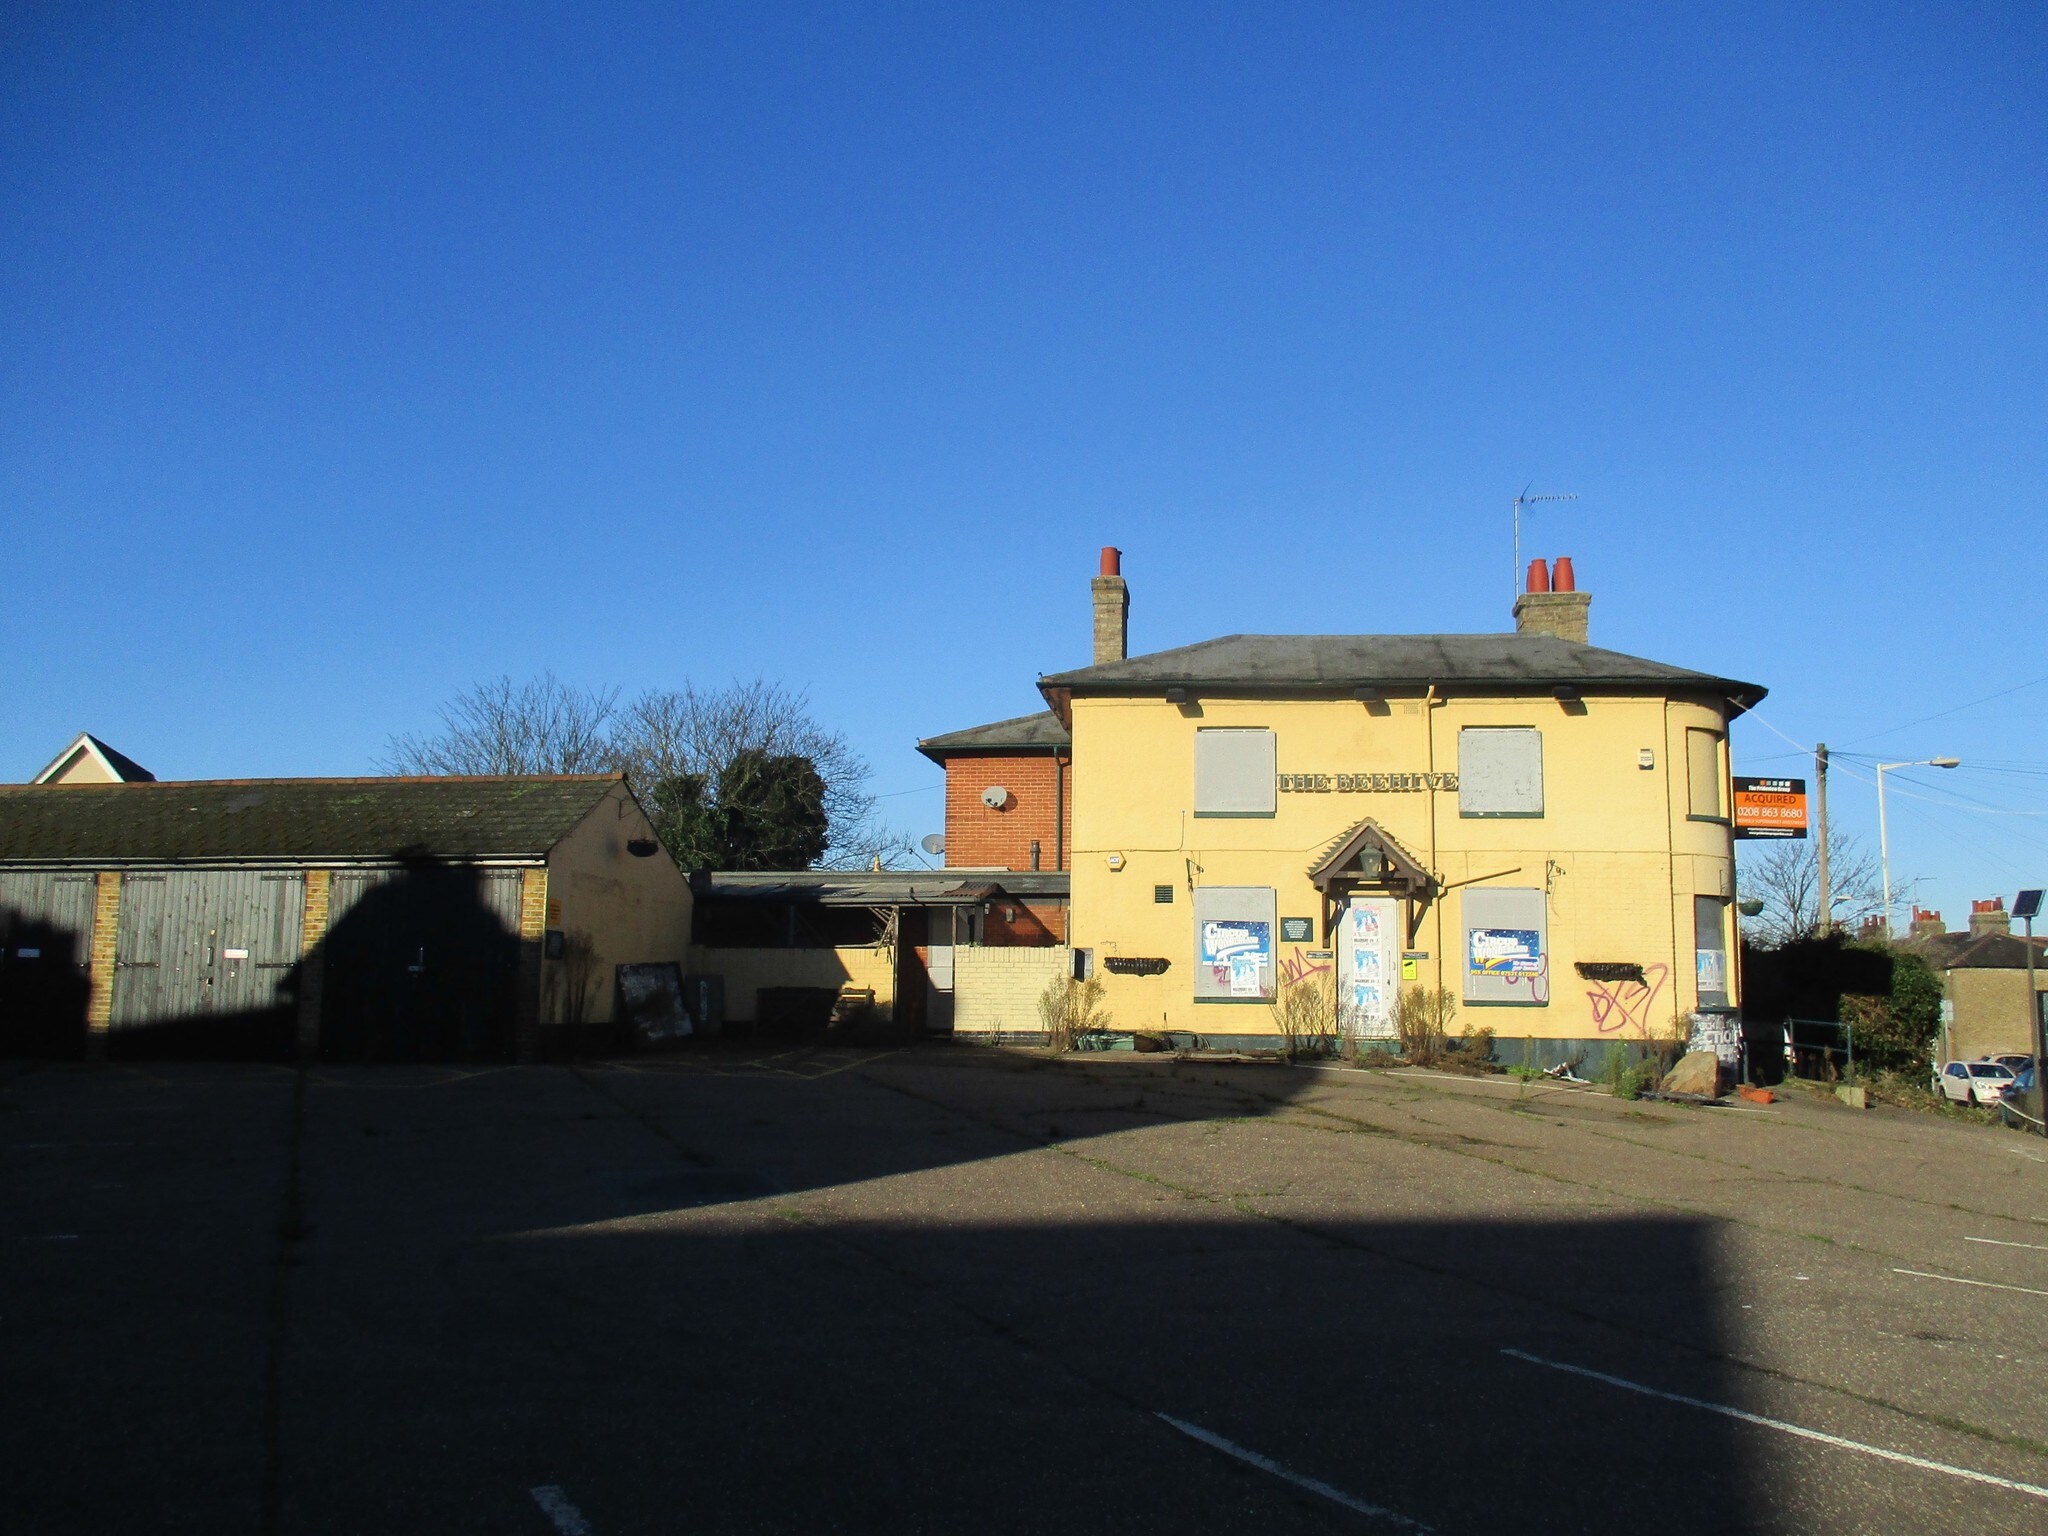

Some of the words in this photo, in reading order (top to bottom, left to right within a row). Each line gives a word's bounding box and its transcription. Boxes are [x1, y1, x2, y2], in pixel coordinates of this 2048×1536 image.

[1277, 773, 1332, 793] THE
[1335, 773, 1459, 793] BEEHIVE
[1744, 794, 1797, 804] ACQUIRED
[1737, 807, 1760, 817] 0208
[1761, 807, 1778, 818] 863
[1780, 808, 1803, 818] 8680
